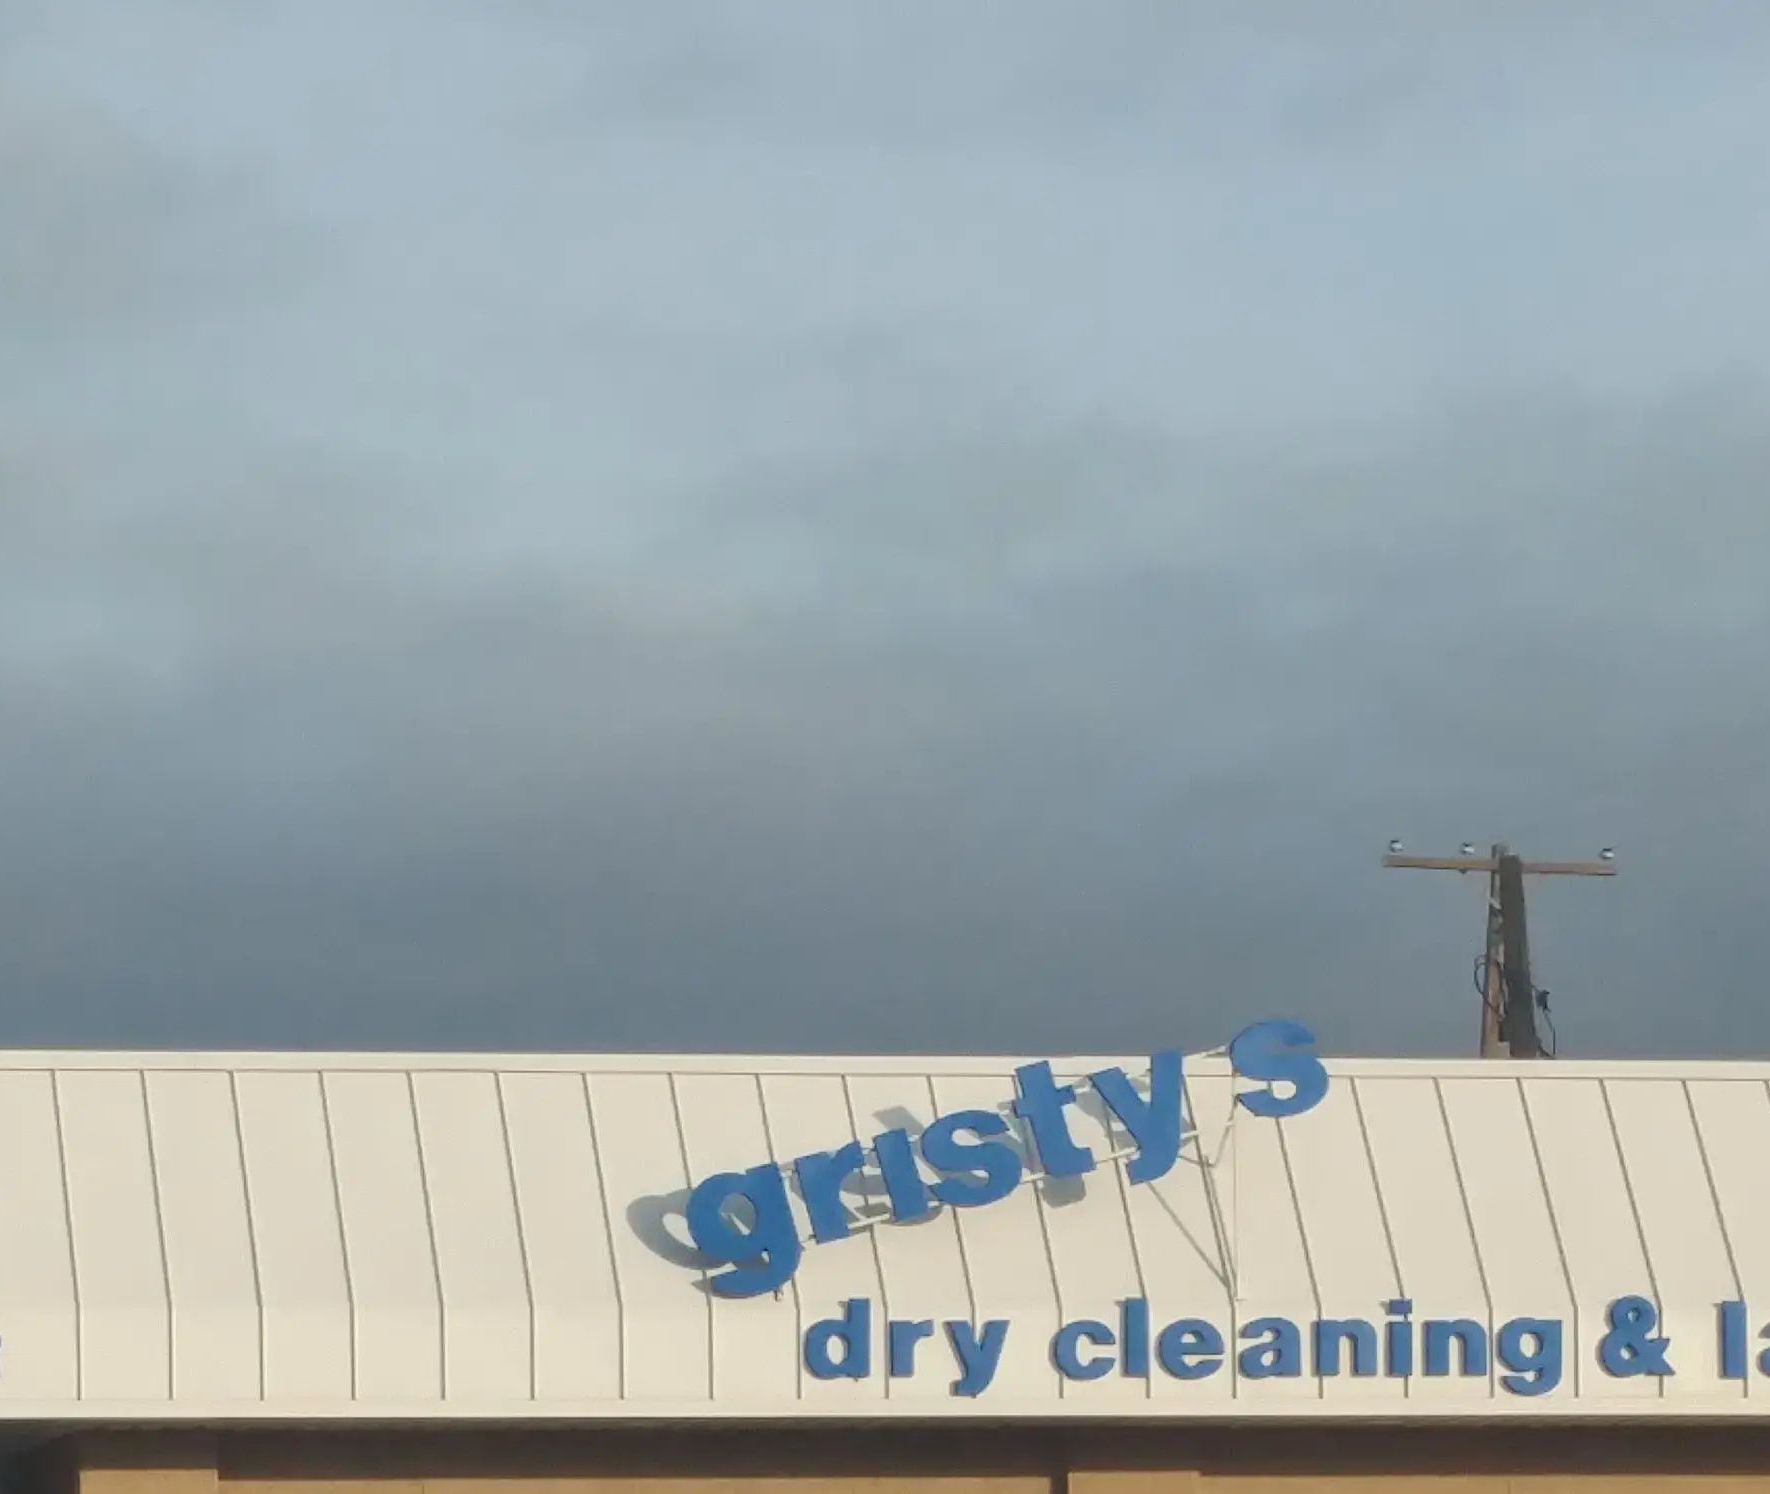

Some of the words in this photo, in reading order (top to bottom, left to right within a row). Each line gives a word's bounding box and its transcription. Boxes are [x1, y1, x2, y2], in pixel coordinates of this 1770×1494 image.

[804, 1298, 1010, 1396] dry
[1049, 1298, 1563, 1396] cleaning
[1595, 1295, 1676, 1378] &
